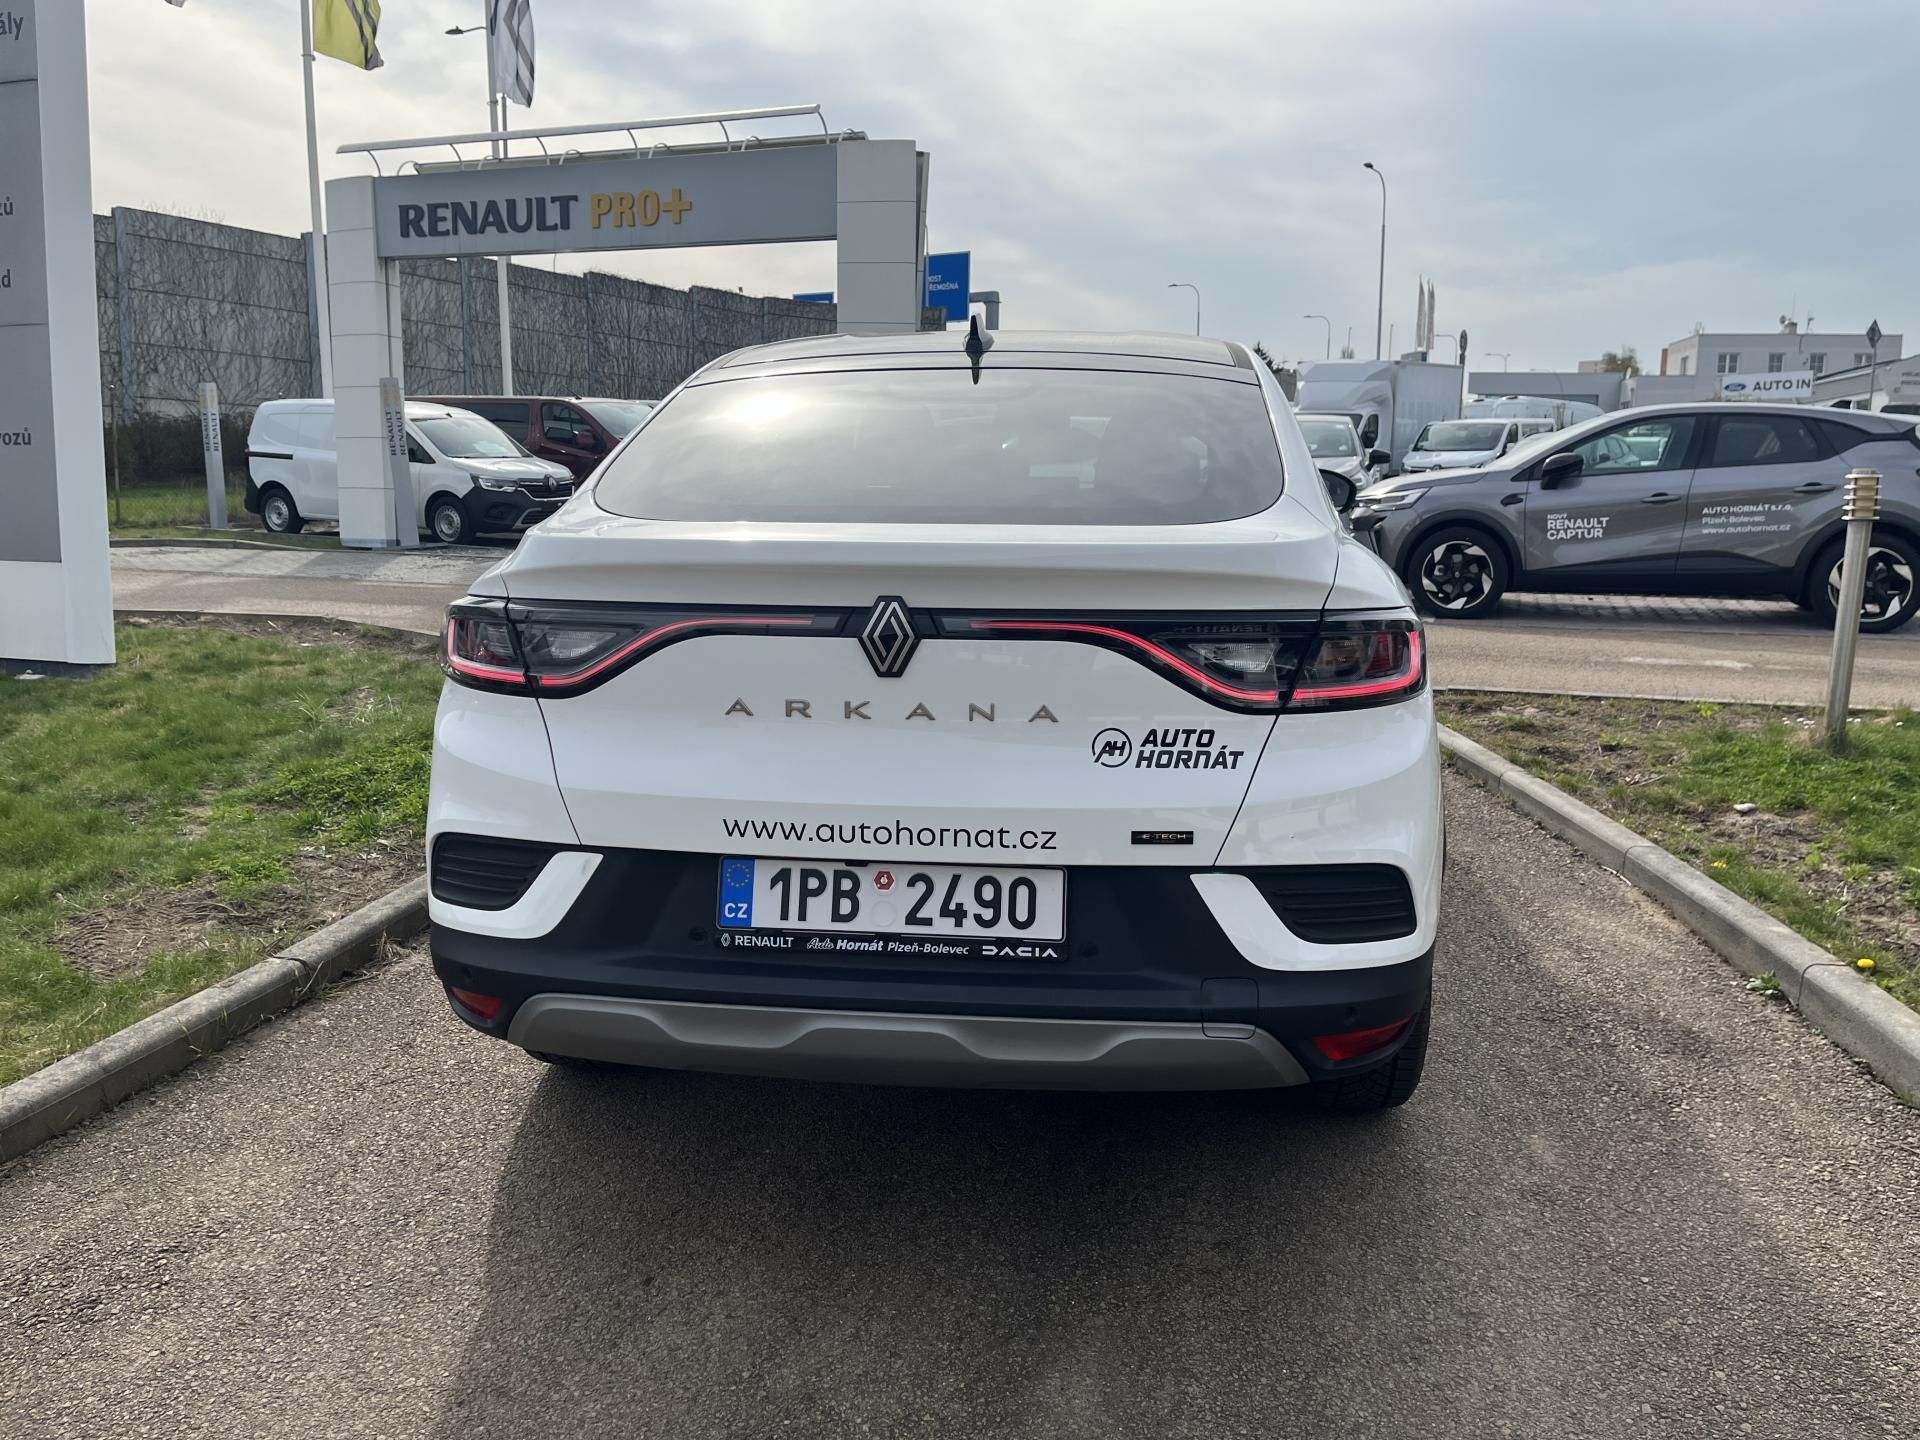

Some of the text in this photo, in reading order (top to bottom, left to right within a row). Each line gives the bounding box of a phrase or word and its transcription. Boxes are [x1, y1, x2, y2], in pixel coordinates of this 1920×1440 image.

[398, 187, 693, 238] RENAULT PRO+
[1753, 380, 1793, 391] AUTO
[1796, 378, 1811, 389] IN
[0, 426, 31, 446] ozů
[385, 408, 397, 456] RENAULT
[1702, 506, 1729, 515] AUTO
[1730, 502, 1770, 513] HORNÁT
[1547, 517, 1610, 530] RENAULT
[1702, 524, 1791, 534] www.autohornat.cz
[1547, 528, 1603, 540] CAPTUR
[725, 697, 1059, 723] ARKANA
[1140, 728, 1216, 748] AUTO
[1135, 745, 1244, 769] HORNÁT
[722, 818, 1057, 850] www.autohornat.cz
[769, 867, 1038, 930] 1PB 2490
[724, 902, 748, 919] CZ
[735, 935, 794, 948] RENAULT
[836, 939, 884, 951] Hornát
[887, 941, 969, 955] Plzeň-Bolevec
[982, 945, 1058, 958] DACIA
